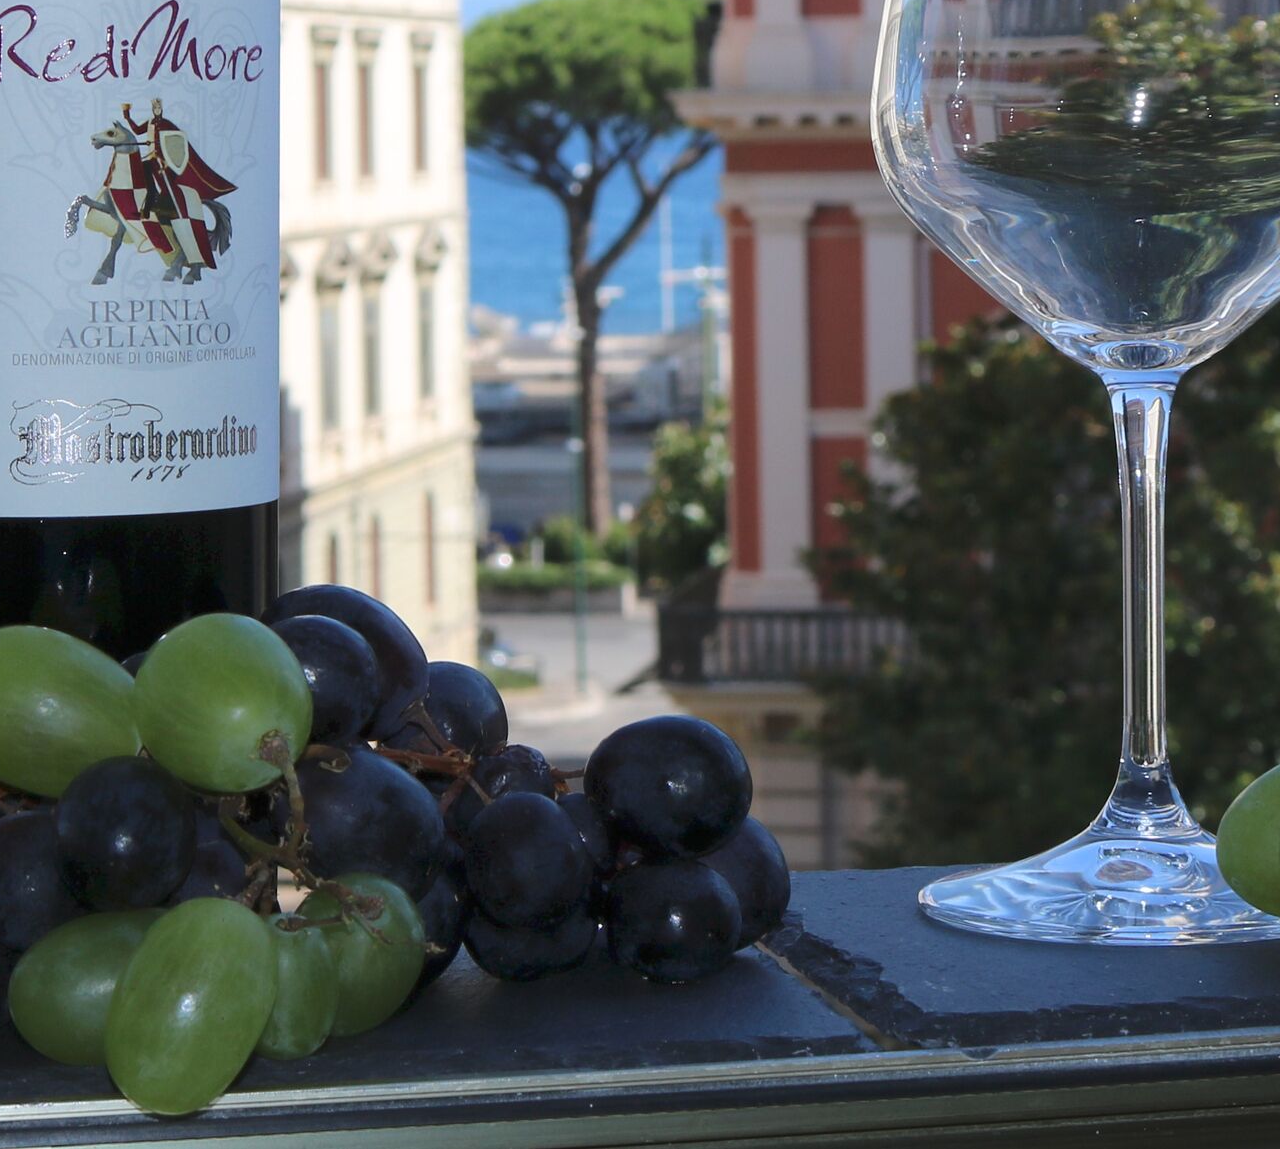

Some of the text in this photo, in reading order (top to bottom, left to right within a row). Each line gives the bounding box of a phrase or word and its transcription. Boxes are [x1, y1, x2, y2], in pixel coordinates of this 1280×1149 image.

[88, 299, 210, 323] IRPINIA
[56, 322, 231, 348] AGLIANICO
[12, 346, 257, 366] DENOMINAZIONE DI ORIGINE CONTROLLATA
[130, 463, 191, 482] 1878
